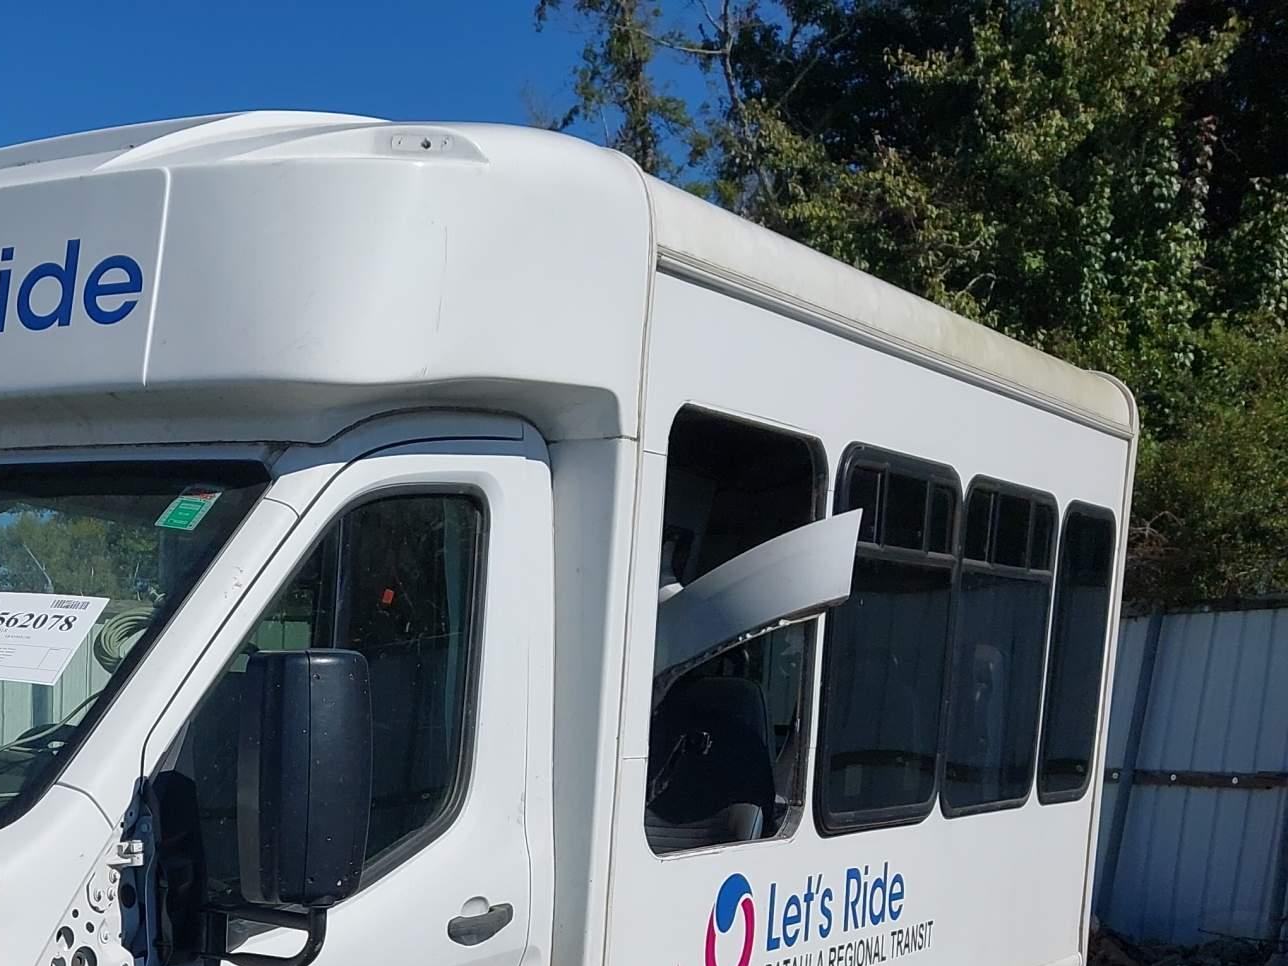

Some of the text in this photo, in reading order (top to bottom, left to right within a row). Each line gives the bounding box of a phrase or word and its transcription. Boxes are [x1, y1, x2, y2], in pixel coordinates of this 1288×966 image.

[766, 862, 905, 951] Let's Ride
[890, 920, 934, 958] TRANSIT
